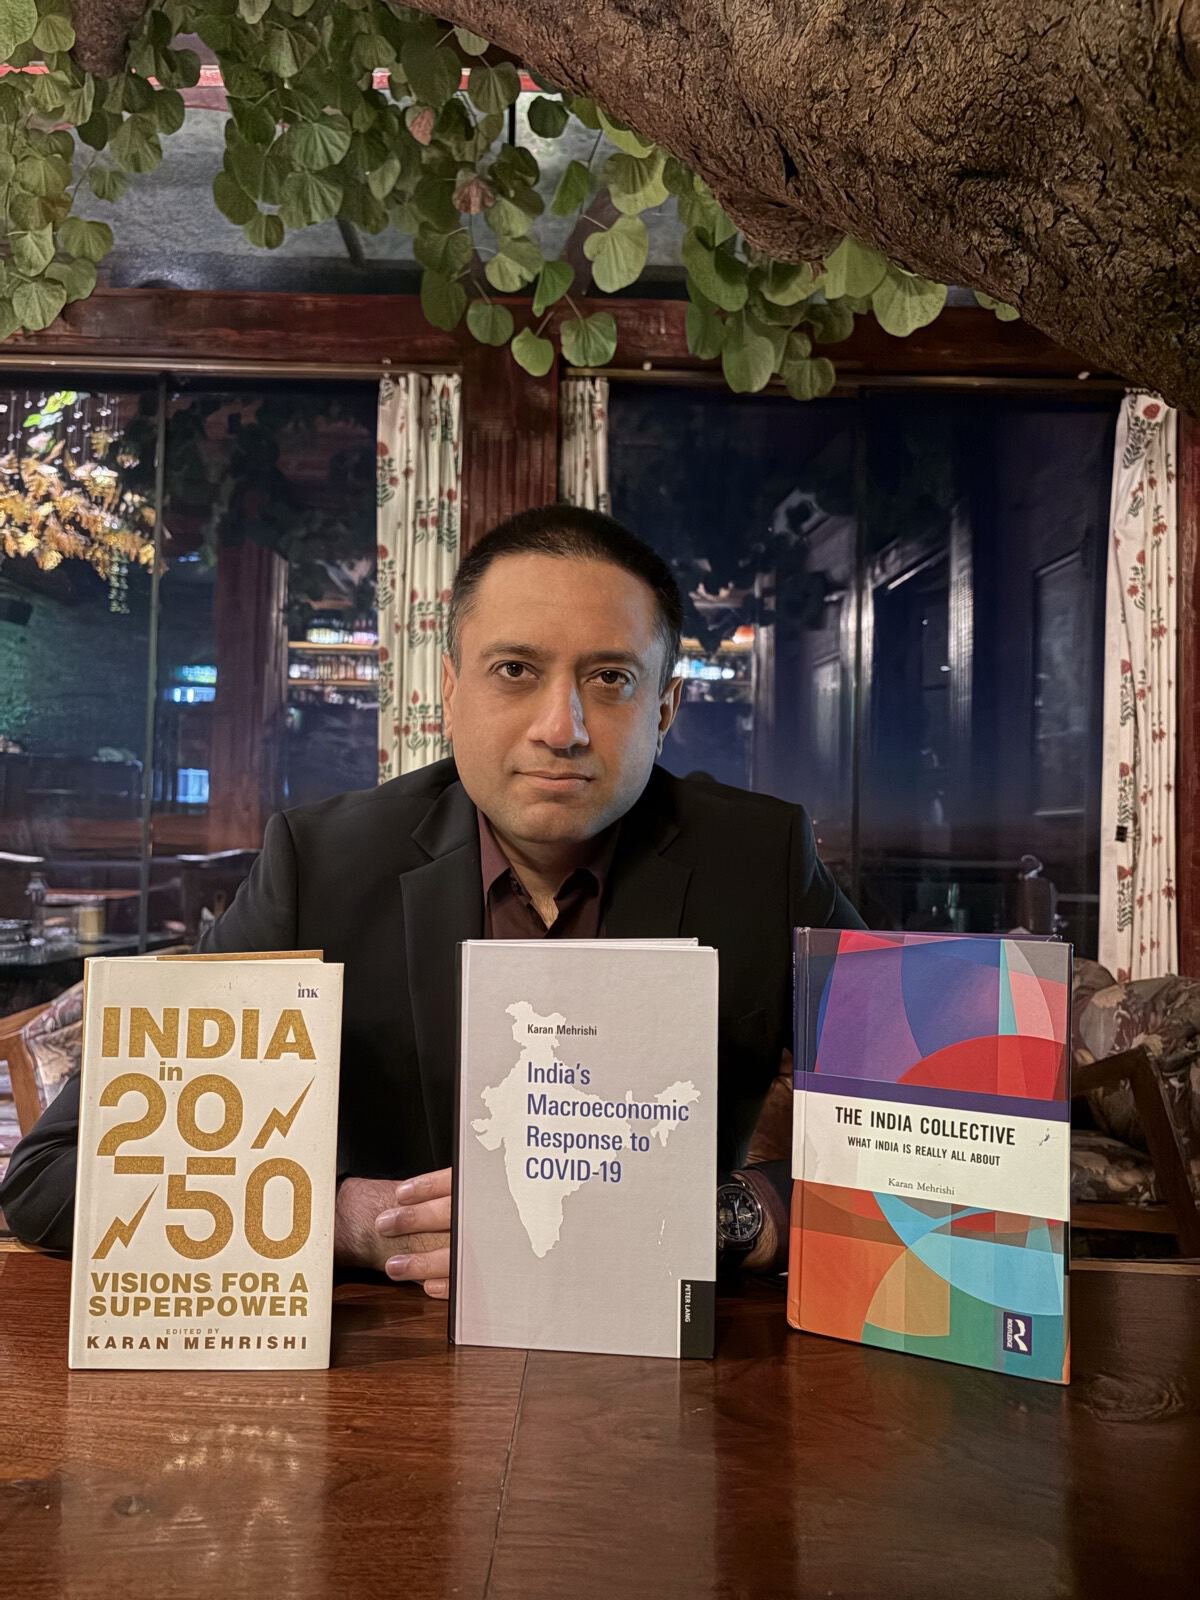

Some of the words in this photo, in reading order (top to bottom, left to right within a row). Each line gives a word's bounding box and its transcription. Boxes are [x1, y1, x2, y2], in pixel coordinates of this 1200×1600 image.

[101, 1007, 317, 1060] INDIA
[527, 1023, 554, 1035] Karan
[556, 1025, 598, 1036] Mehrishi
[159, 1061, 183, 1081] in
[527, 1061, 591, 1085] India's
[527, 1093, 690, 1122] Macroeconomic
[835, 1106, 862, 1126] THE
[870, 1110, 913, 1133] INDIA
[920, 1117, 1016, 1146] COLLECTIVE
[526, 1125, 623, 1154] Response
[630, 1133, 650, 1152] to
[847, 1136, 871, 1149] WHAT
[875, 1140, 899, 1153] INDIA
[903, 1144, 911, 1154] IS
[915, 1146, 947, 1159] REALLY
[951, 1150, 966, 1162] ALL
[970, 1153, 1000, 1167] ABOUT
[525, 1157, 622, 1183] COVID-19
[888, 1177, 914, 1190] Karan
[916, 1182, 955, 1196] Mehrishi
[91, 1272, 212, 1294] VISIONS
[221, 1272, 280, 1294] FOR
[289, 1272, 309, 1293] A
[88, 1295, 309, 1317] SUPERPOWER
[86, 1335, 169, 1350] KARAN
[183, 1336, 308, 1350] MEHRISHI
